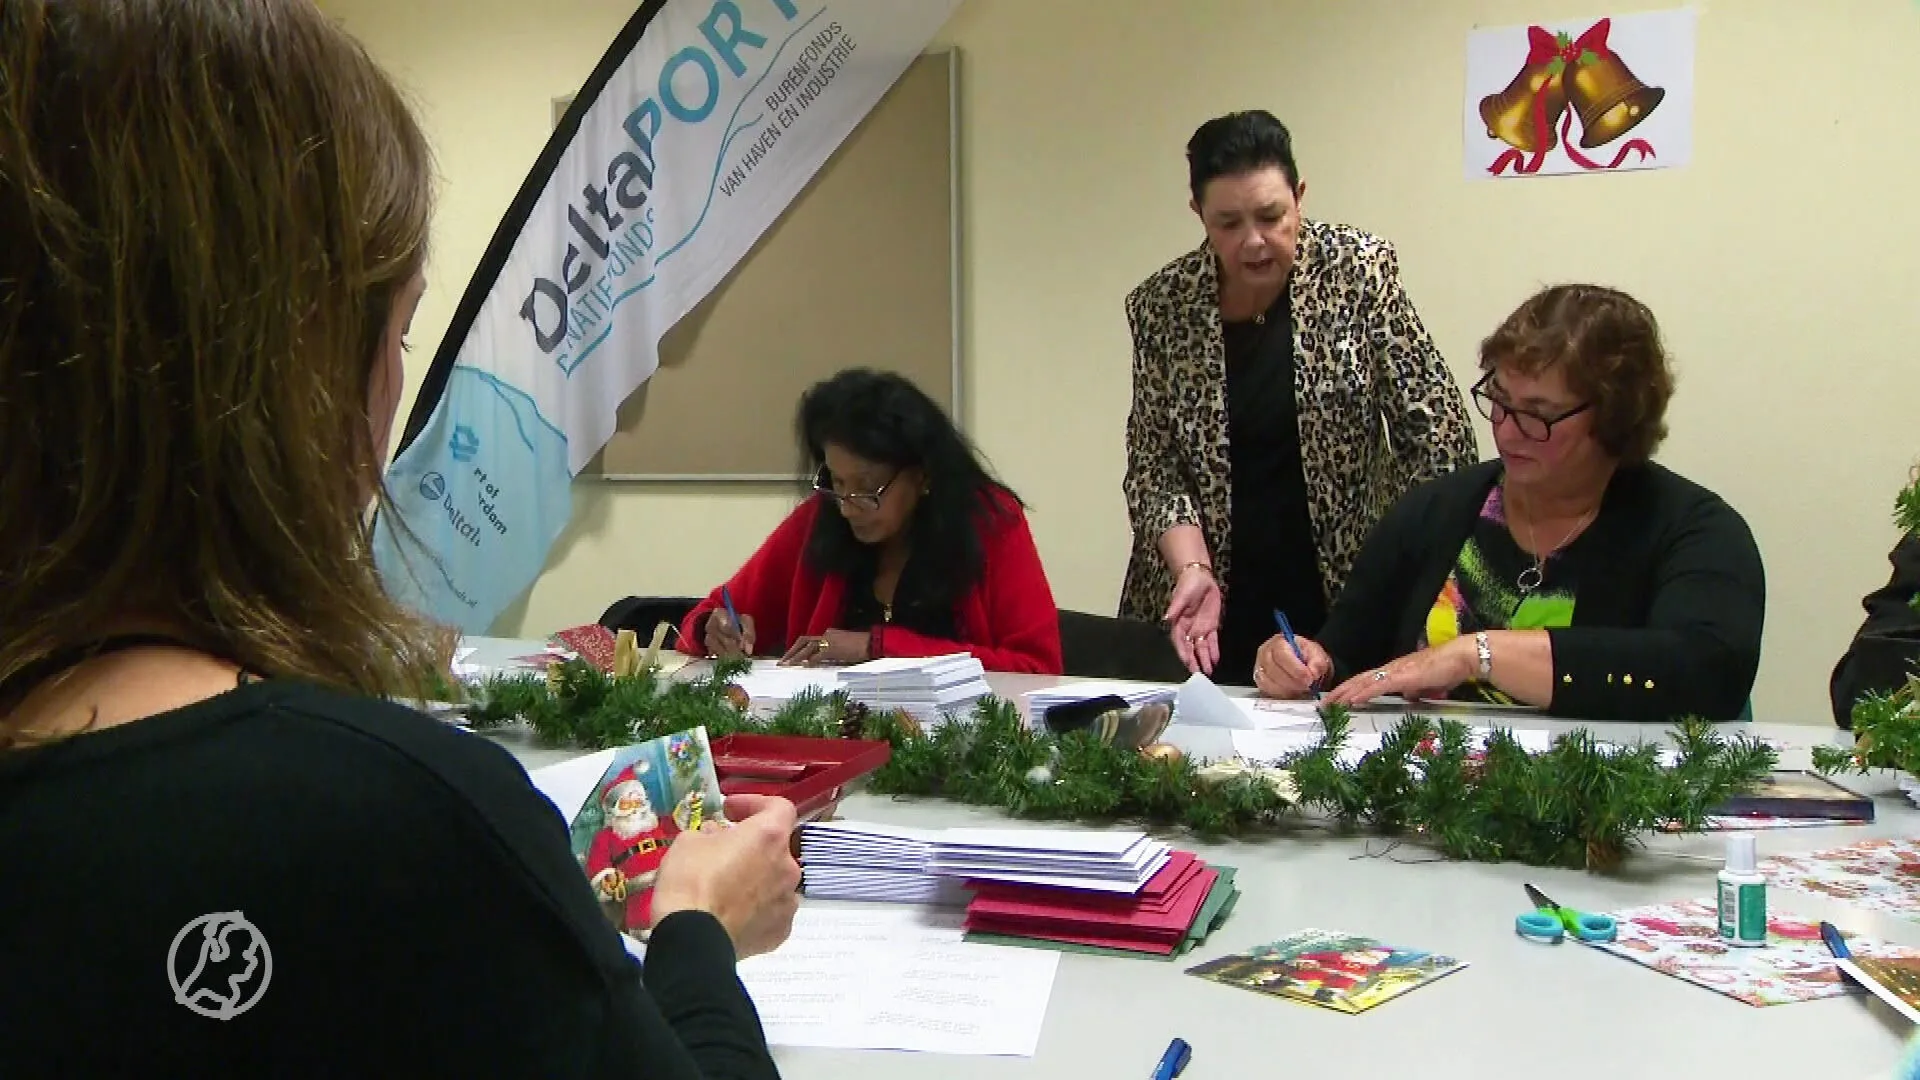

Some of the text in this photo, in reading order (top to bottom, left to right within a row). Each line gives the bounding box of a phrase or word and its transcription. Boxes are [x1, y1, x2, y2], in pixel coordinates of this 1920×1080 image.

[765, 21, 842, 112] BURENFONDS
[719, 33, 857, 197] VAN HAVEN EN INDUSTRIE
[485, 483, 499, 498] of
